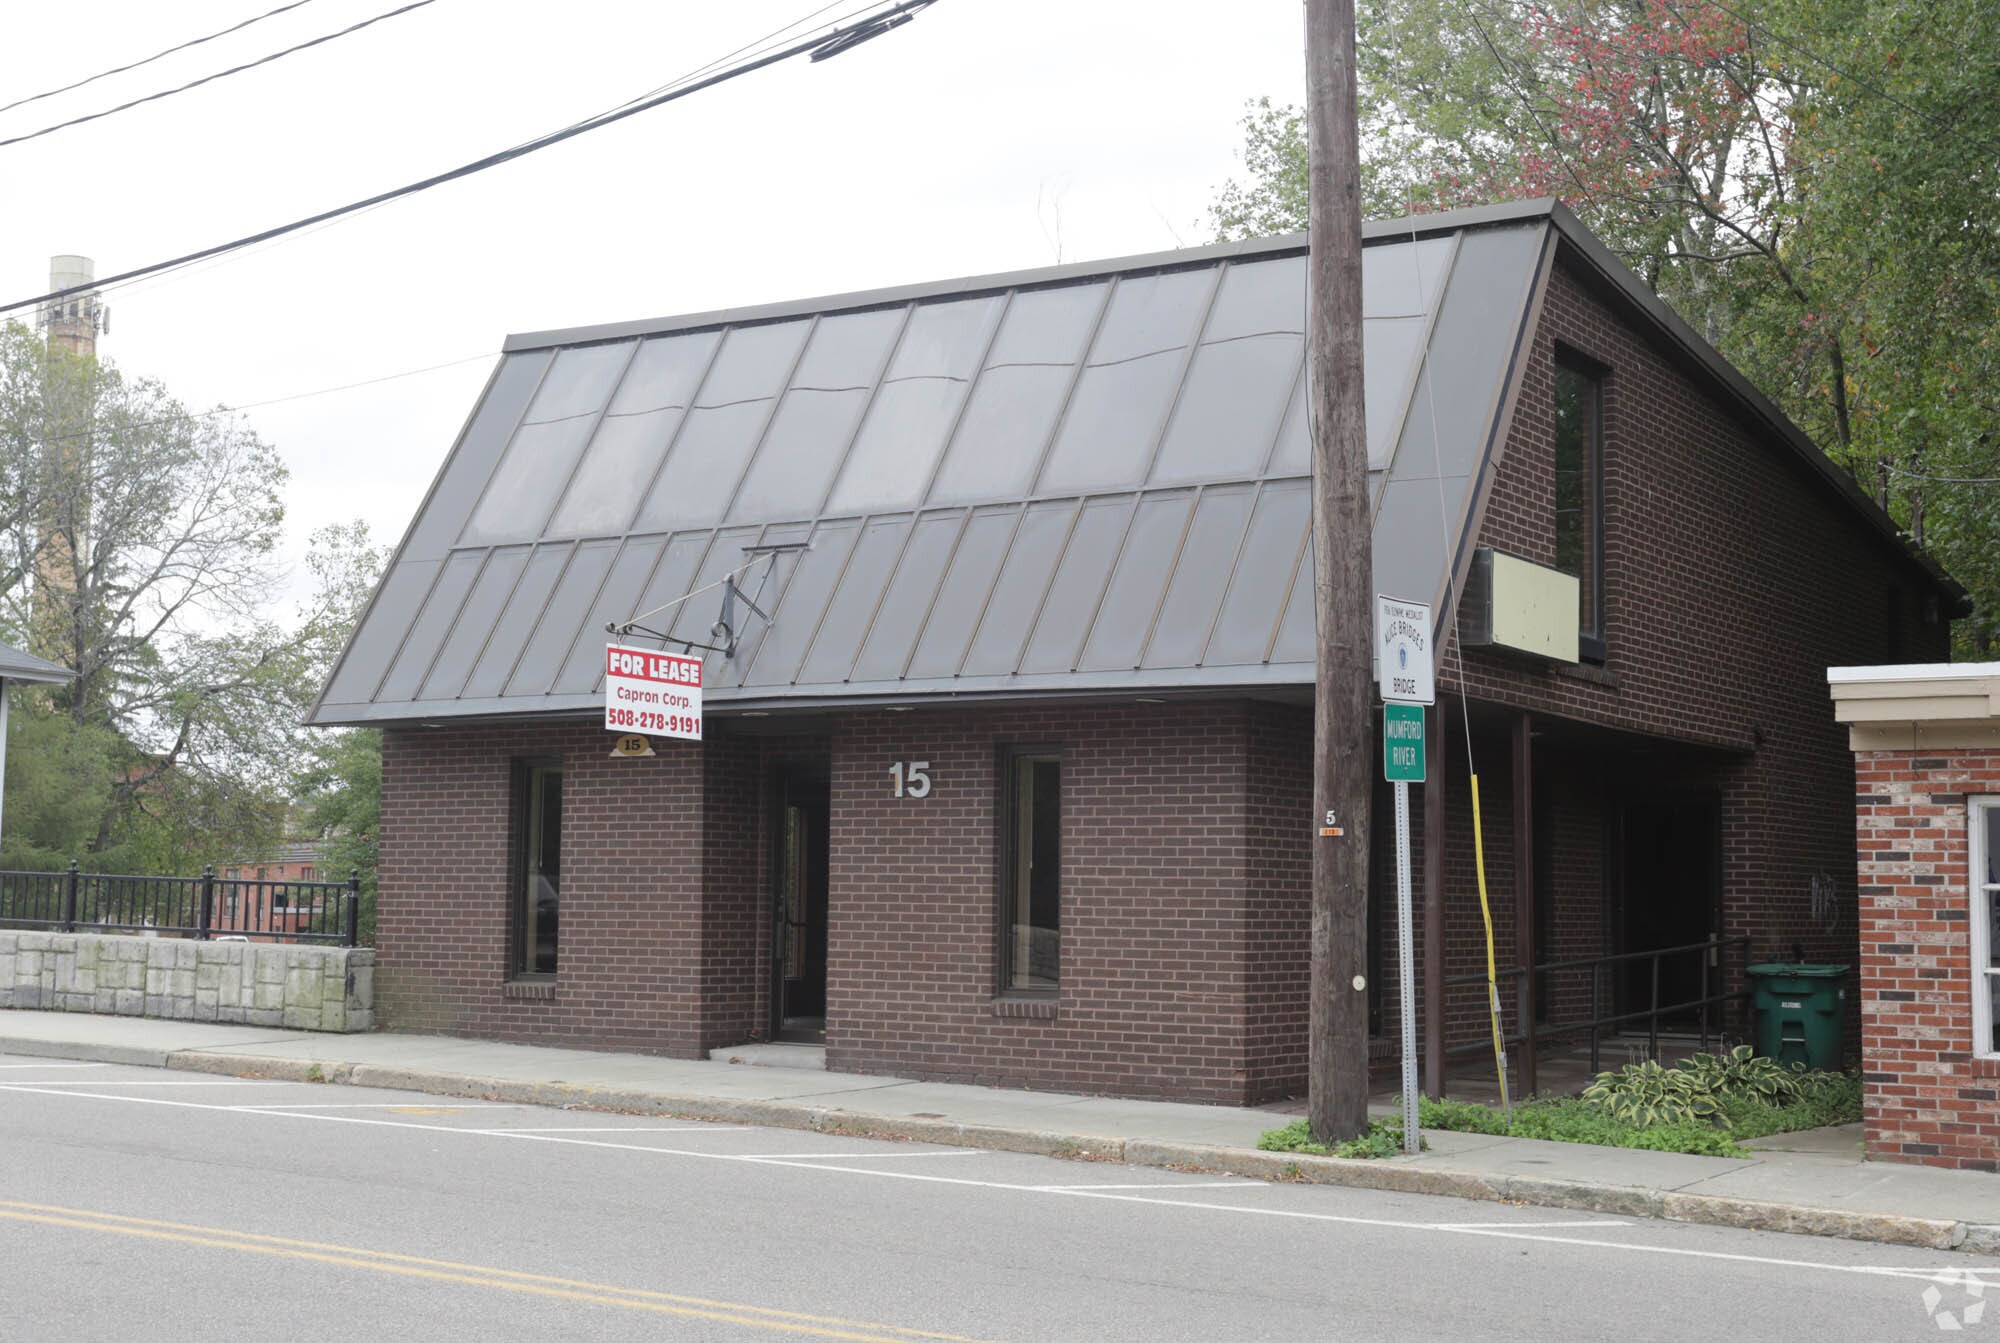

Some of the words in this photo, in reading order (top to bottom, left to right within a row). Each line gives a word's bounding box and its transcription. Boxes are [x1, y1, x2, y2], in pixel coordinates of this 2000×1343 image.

[1399, 620, 1424, 651] BRIDGES
[610, 652, 644, 676] FOR
[649, 658, 699, 684] LEASE
[1393, 678, 1416, 694] BRIDGE
[617, 686, 659, 703] Capron
[663, 693, 692, 709] Corp.
[609, 708, 700, 734] 508-278-9191
[1387, 719, 1422, 740] MUMFORD
[624, 739, 640, 751] 15
[1393, 747, 1416, 766] RIVER
[889, 761, 931, 798] 15
[1326, 810, 1336, 825] 5
